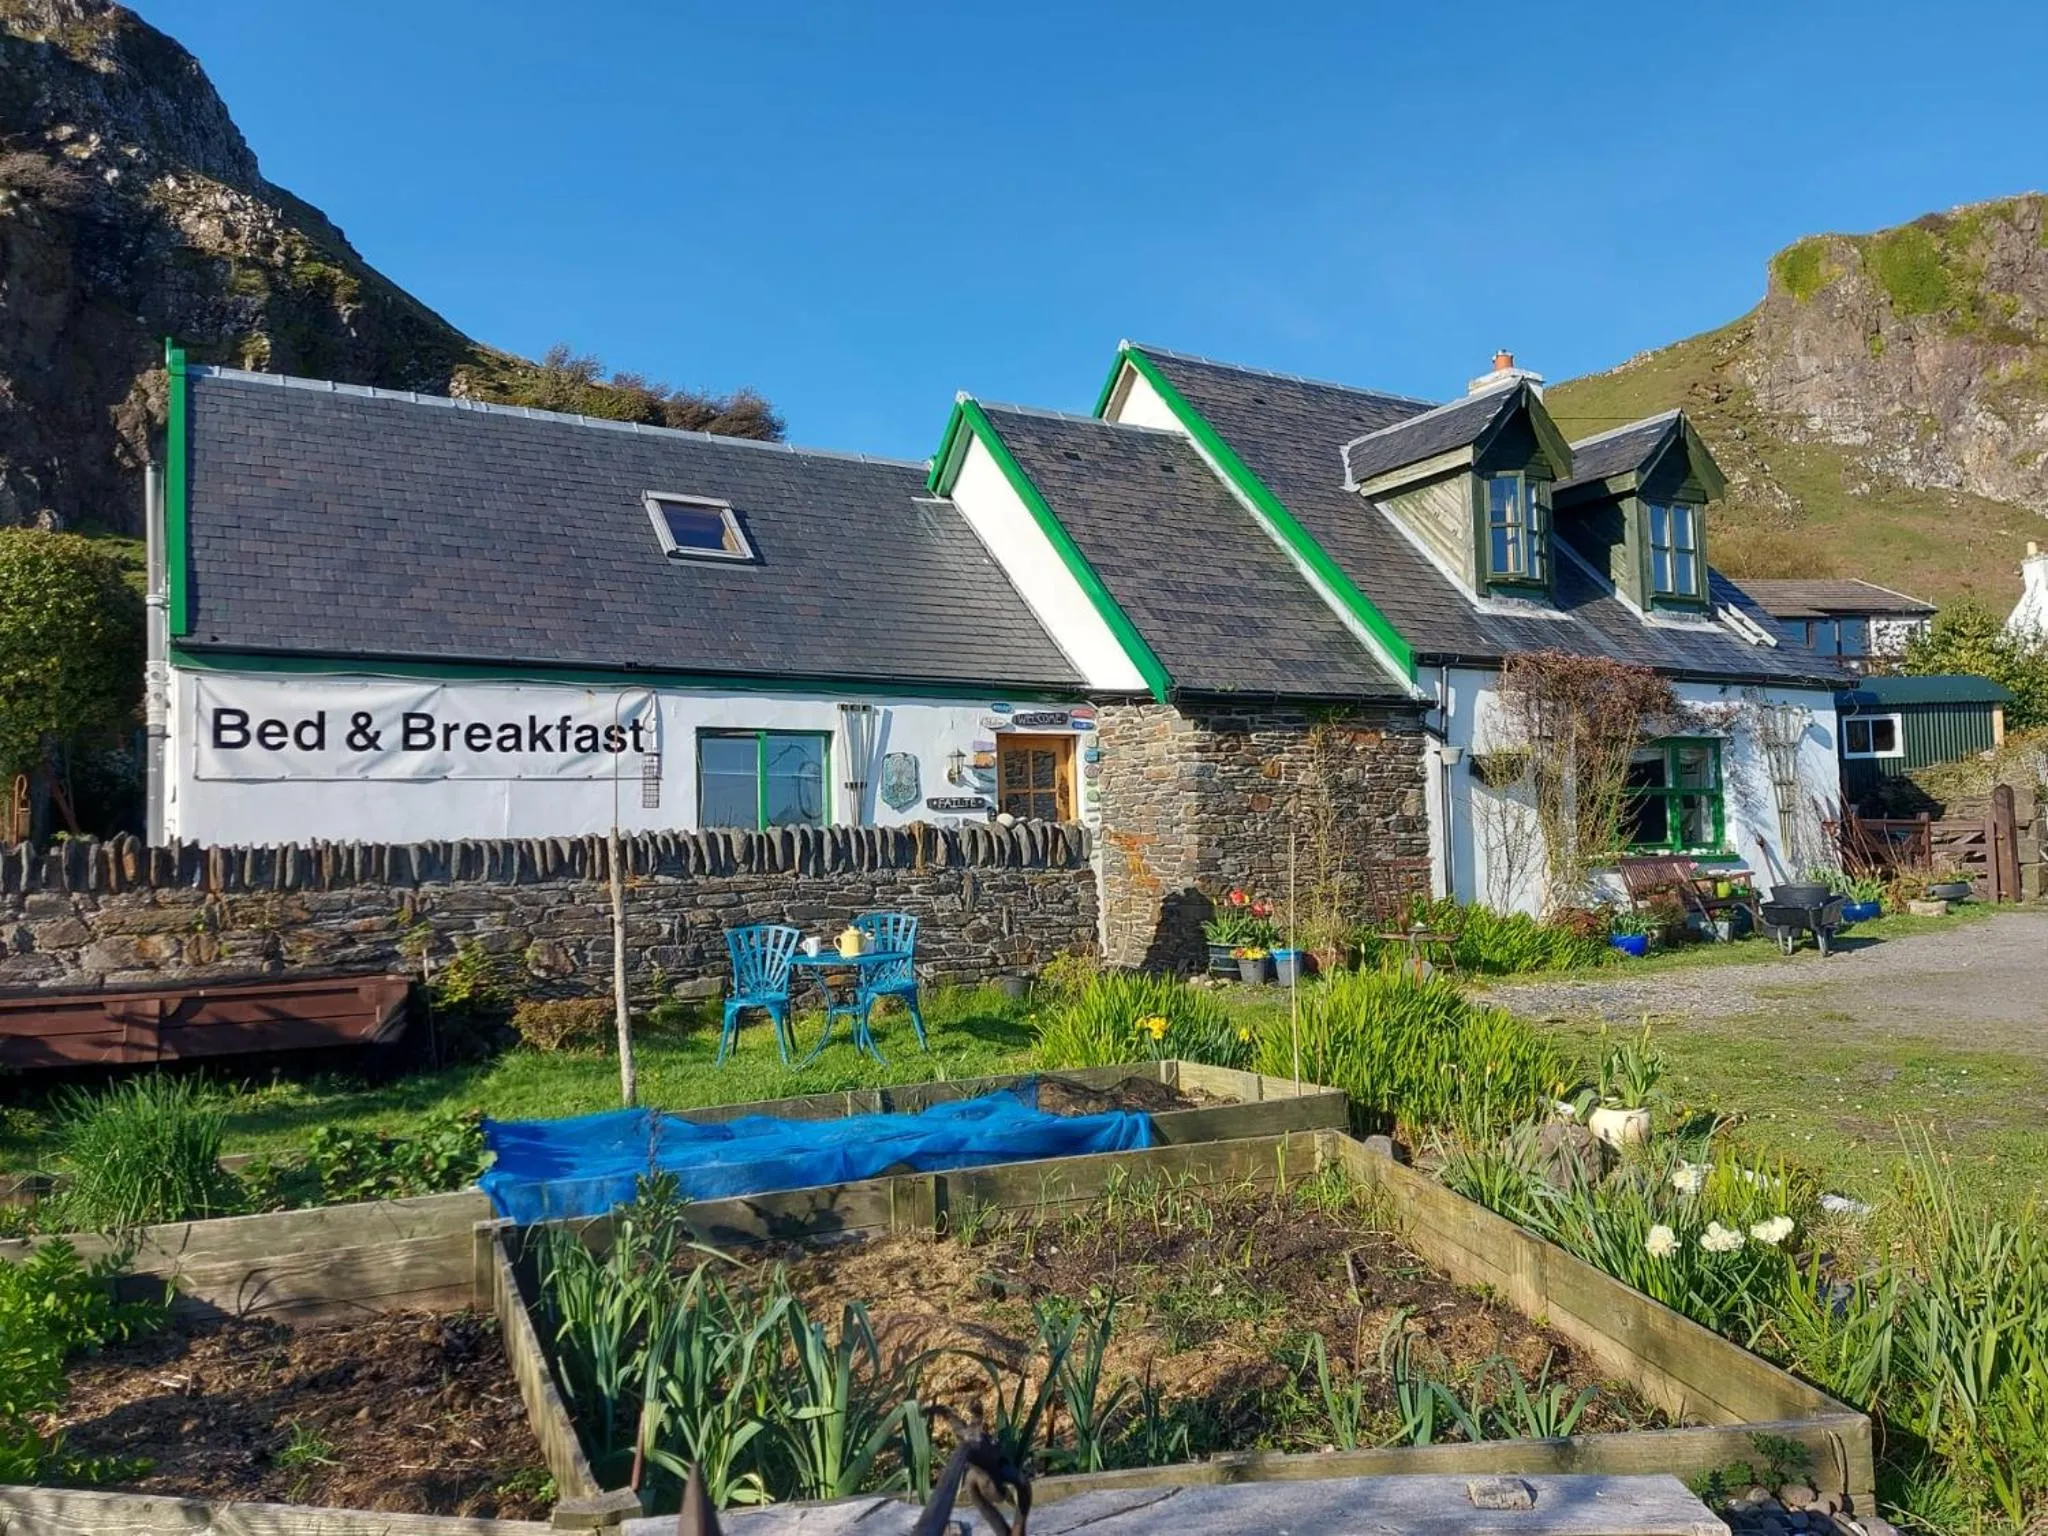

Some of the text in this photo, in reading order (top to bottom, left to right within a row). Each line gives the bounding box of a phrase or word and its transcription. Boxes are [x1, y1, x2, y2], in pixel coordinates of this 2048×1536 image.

[212, 708, 645, 753] Bed & Breakfast
[1017, 713, 1062, 725] WELCOME
